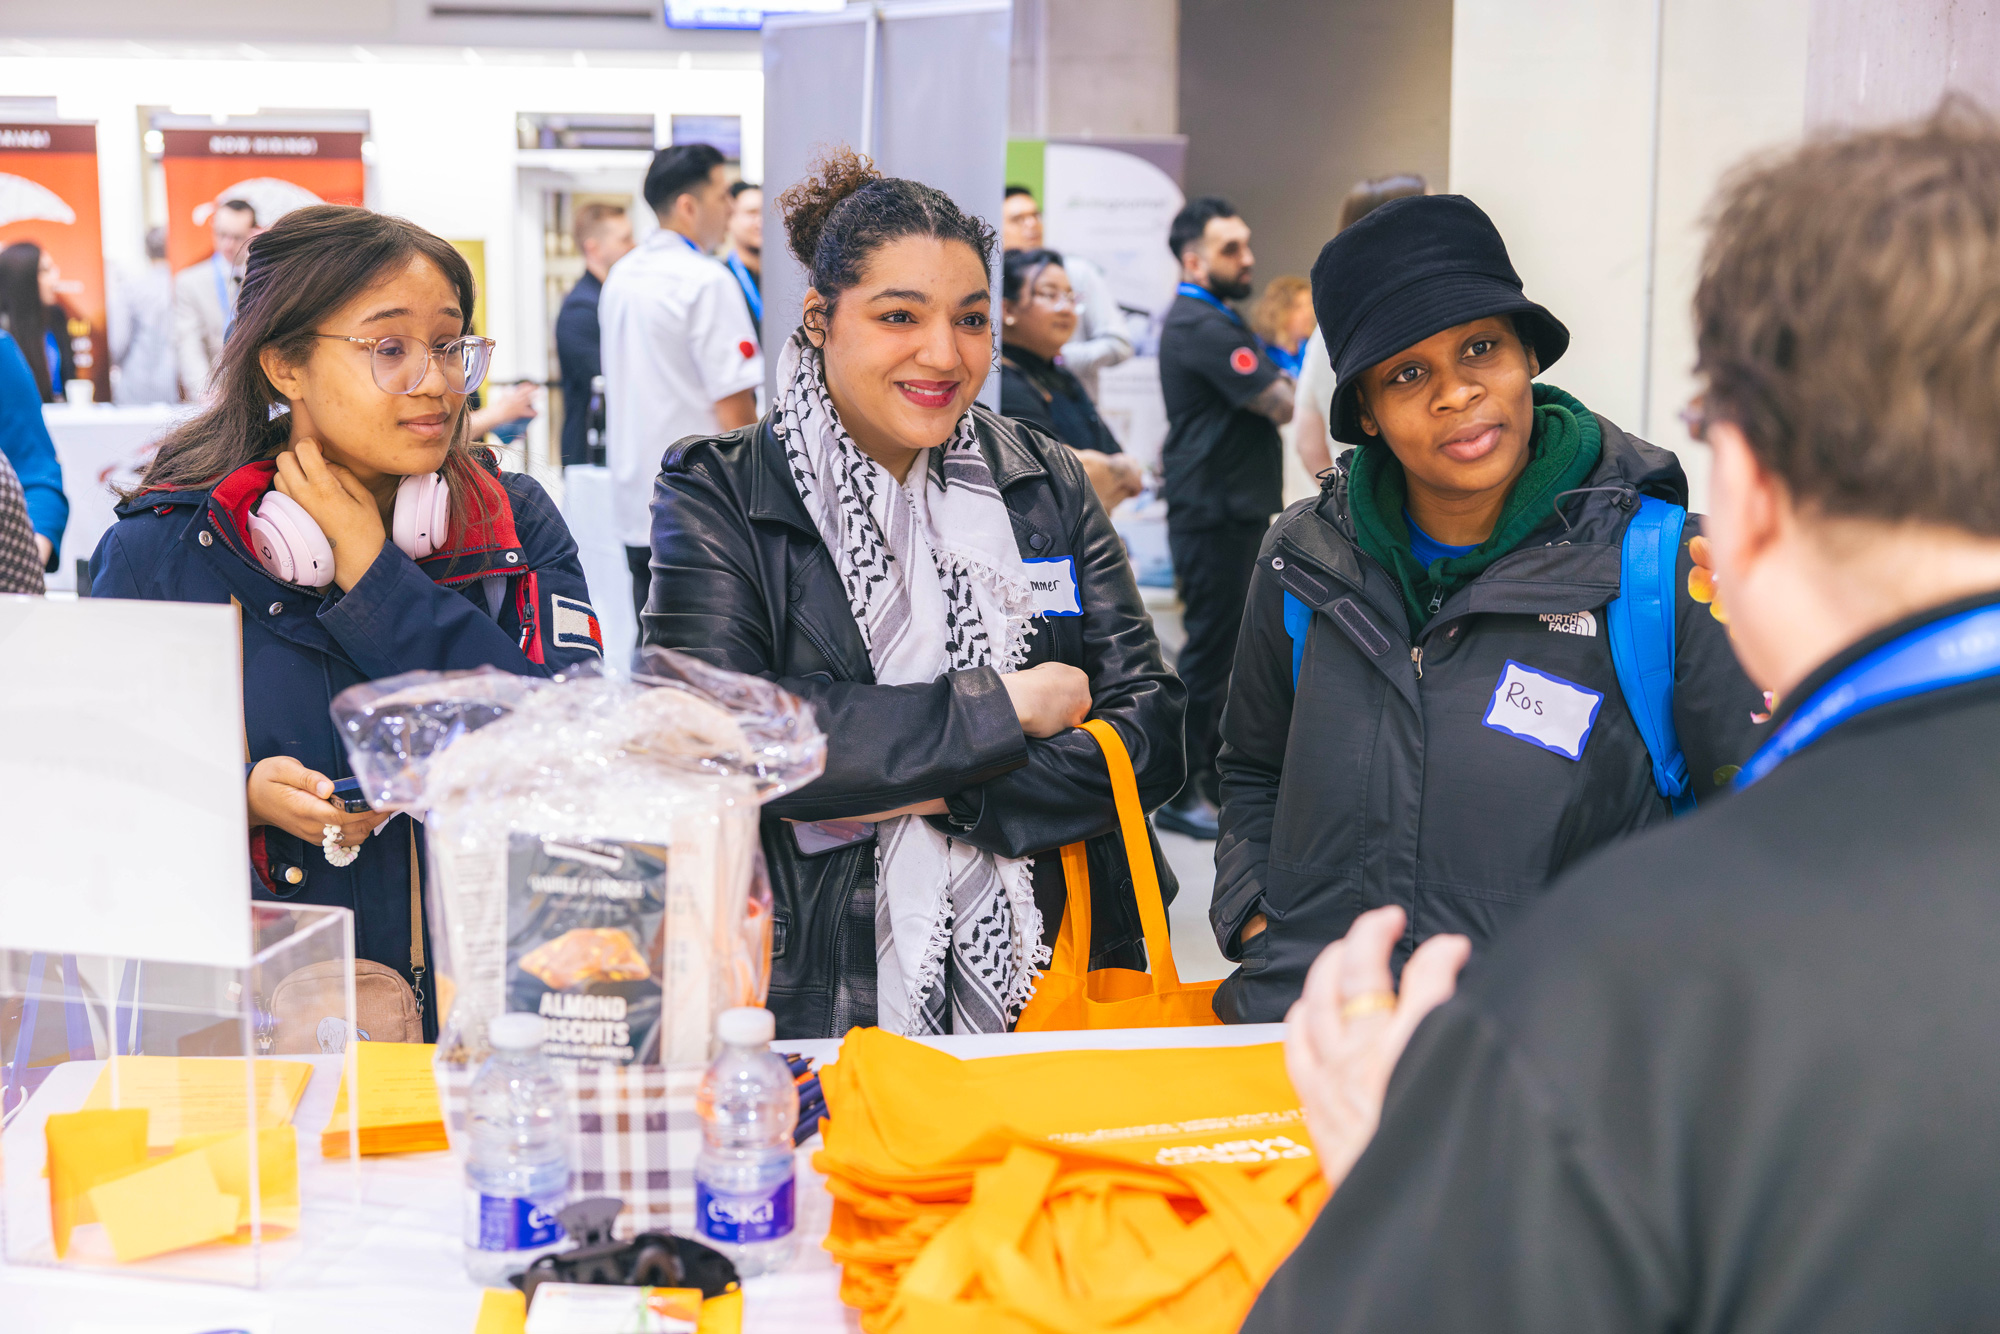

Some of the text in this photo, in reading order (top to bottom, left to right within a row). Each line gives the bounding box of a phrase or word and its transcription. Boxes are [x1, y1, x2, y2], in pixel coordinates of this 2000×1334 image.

[1030, 580, 1060, 592] mmer
[1538, 613, 1578, 625] NORTH
[1548, 622, 1577, 634] FACE
[1506, 682, 1543, 715] Ros
[538, 992, 627, 1021] ALMOND
